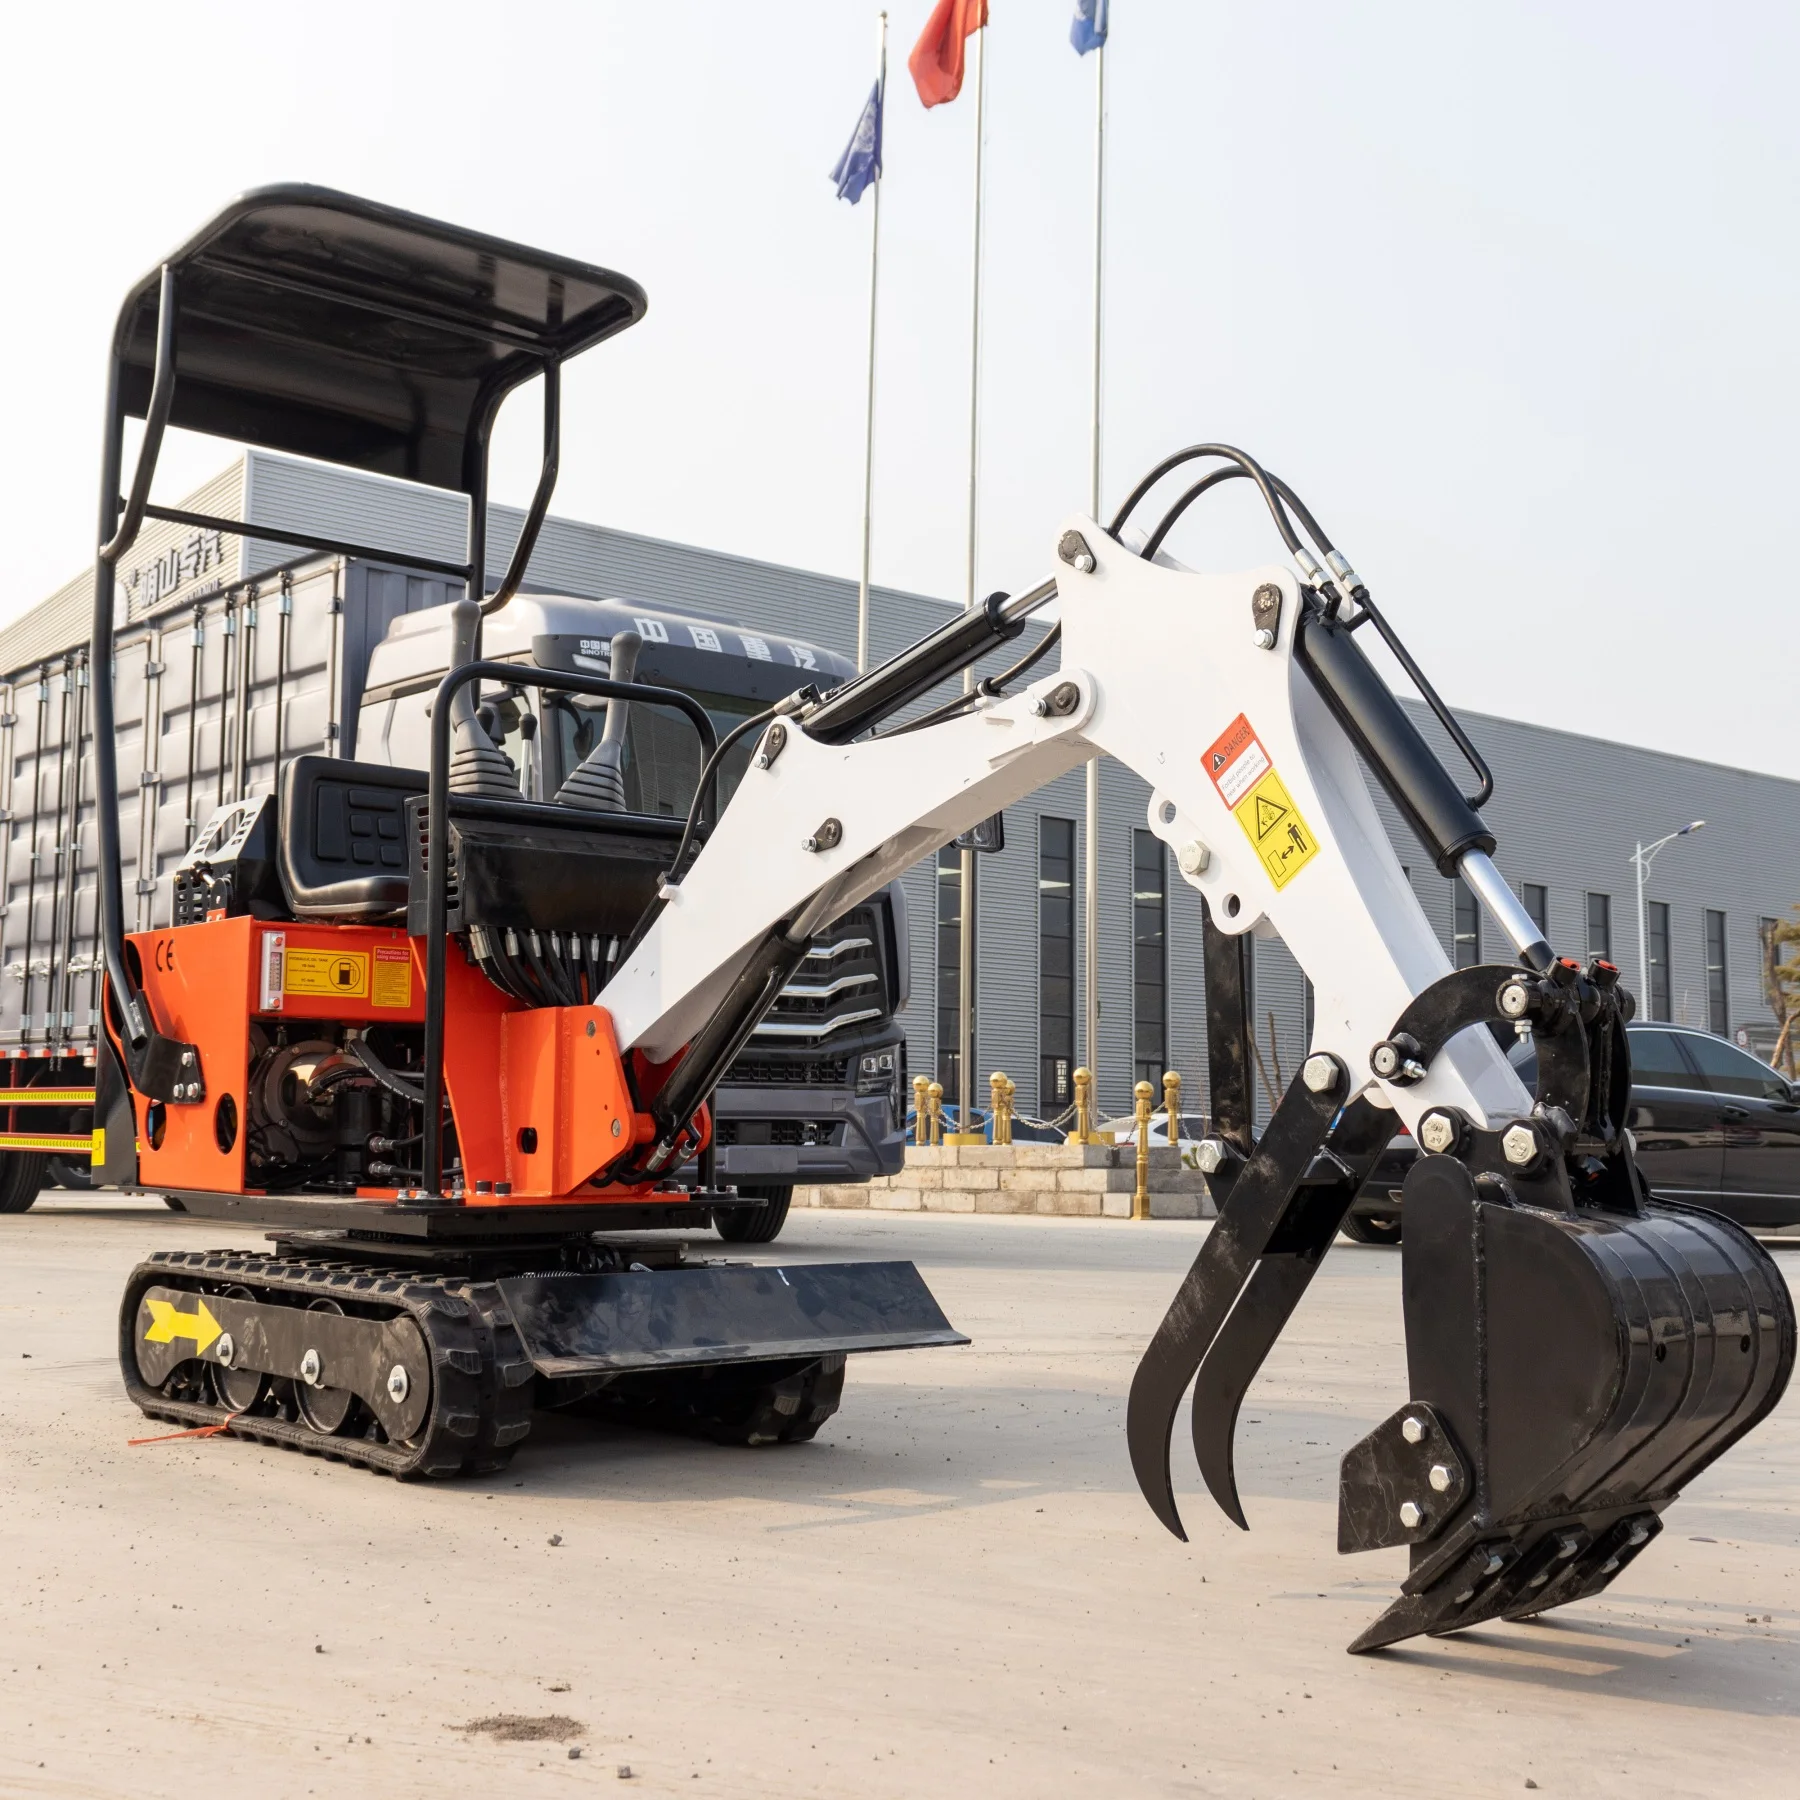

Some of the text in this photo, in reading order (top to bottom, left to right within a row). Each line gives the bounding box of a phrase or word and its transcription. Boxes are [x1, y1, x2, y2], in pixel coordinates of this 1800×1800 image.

[580, 640, 611, 650] 中国重
[580, 648, 612, 657] SINOTR
[633, 617, 821, 673] 中国重汽
[1224, 727, 1250, 756] DANGER
[1235, 759, 1250, 777] people
[1236, 774, 1248, 788] when
[1247, 756, 1265, 776] working
[155, 939, 174, 972] CE
